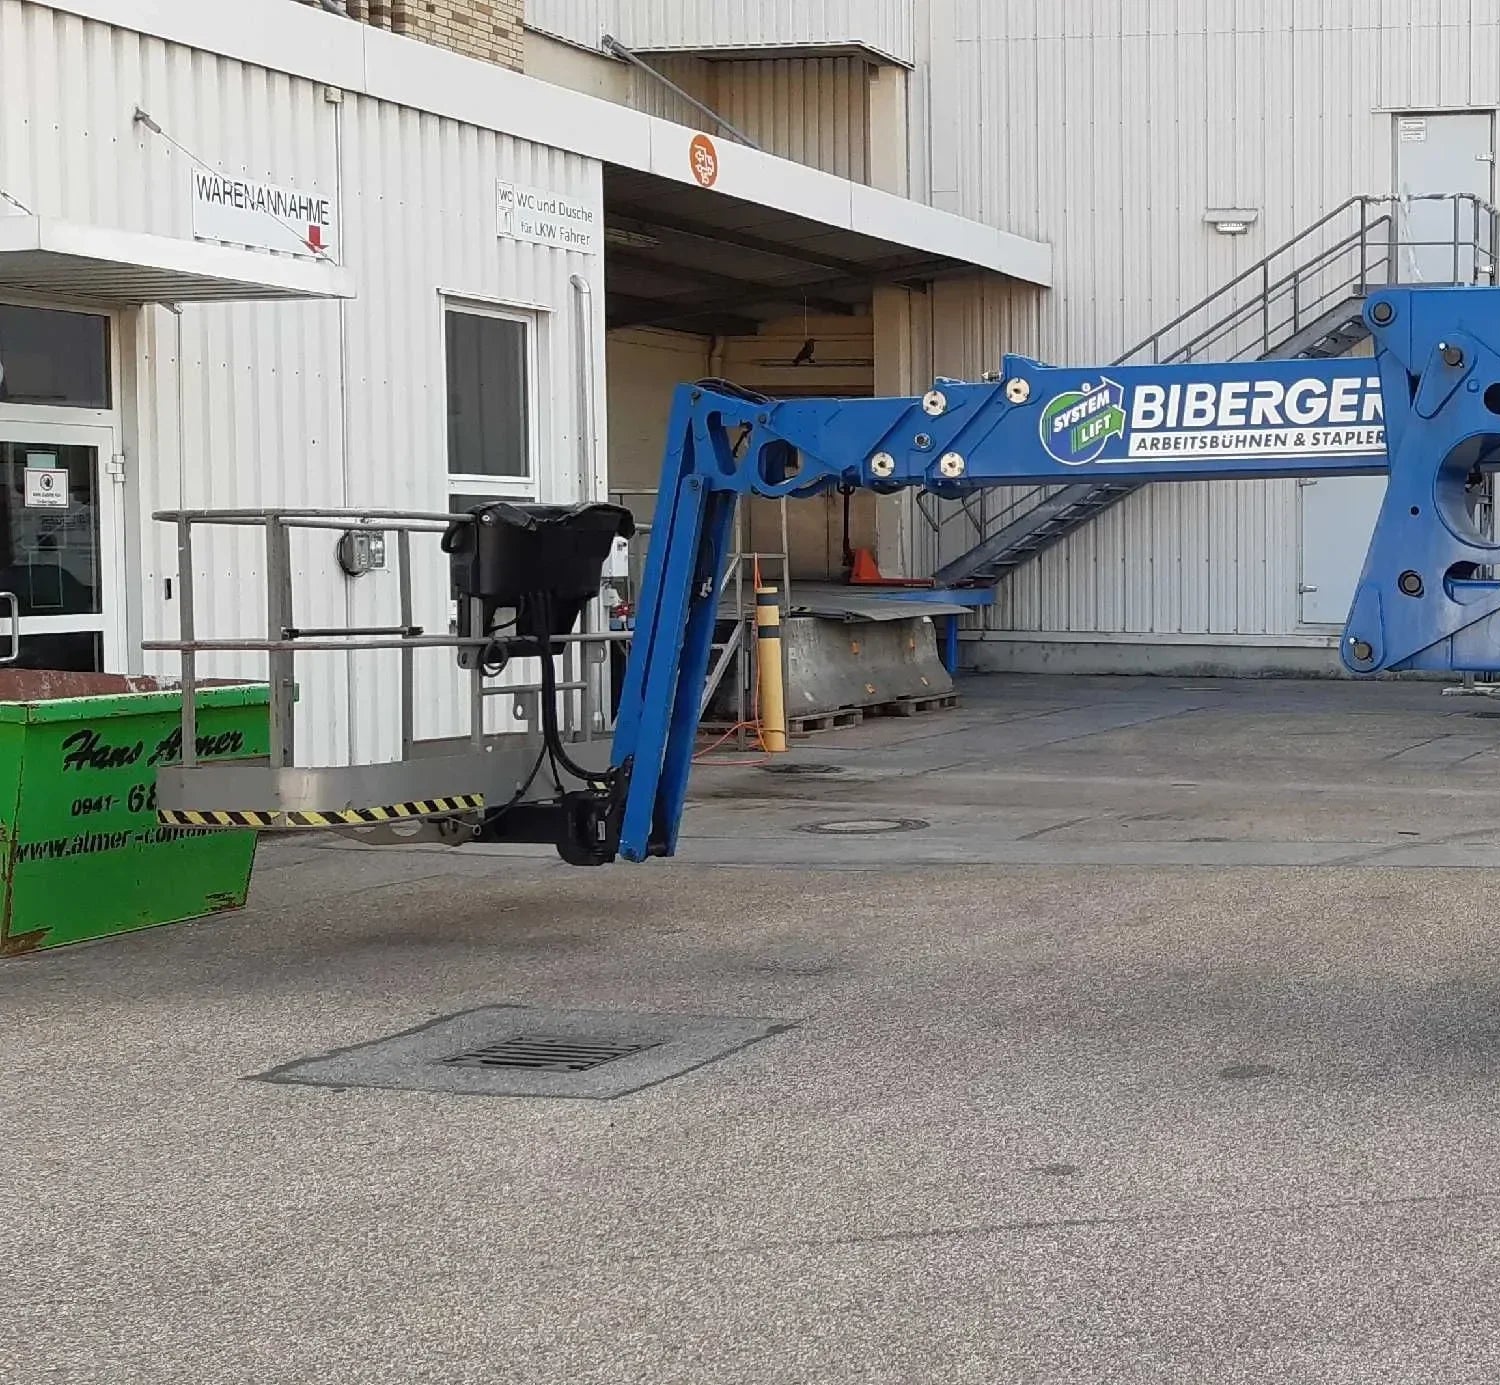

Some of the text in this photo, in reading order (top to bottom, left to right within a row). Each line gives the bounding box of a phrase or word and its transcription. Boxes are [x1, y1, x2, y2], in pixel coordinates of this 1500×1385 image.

[196, 174, 329, 226] WARENANNAHME
[499, 188, 513, 202] WC
[517, 191, 593, 223] WC und Dusche
[521, 221, 591, 245] für LKW Fahrer
[1053, 389, 1111, 433] SYSTEM
[1081, 413, 1112, 443] LIFT
[1136, 430, 1385, 451] ARBEITSBÜHNEN & STAPLER
[62, 723, 244, 772] Hans Amer
